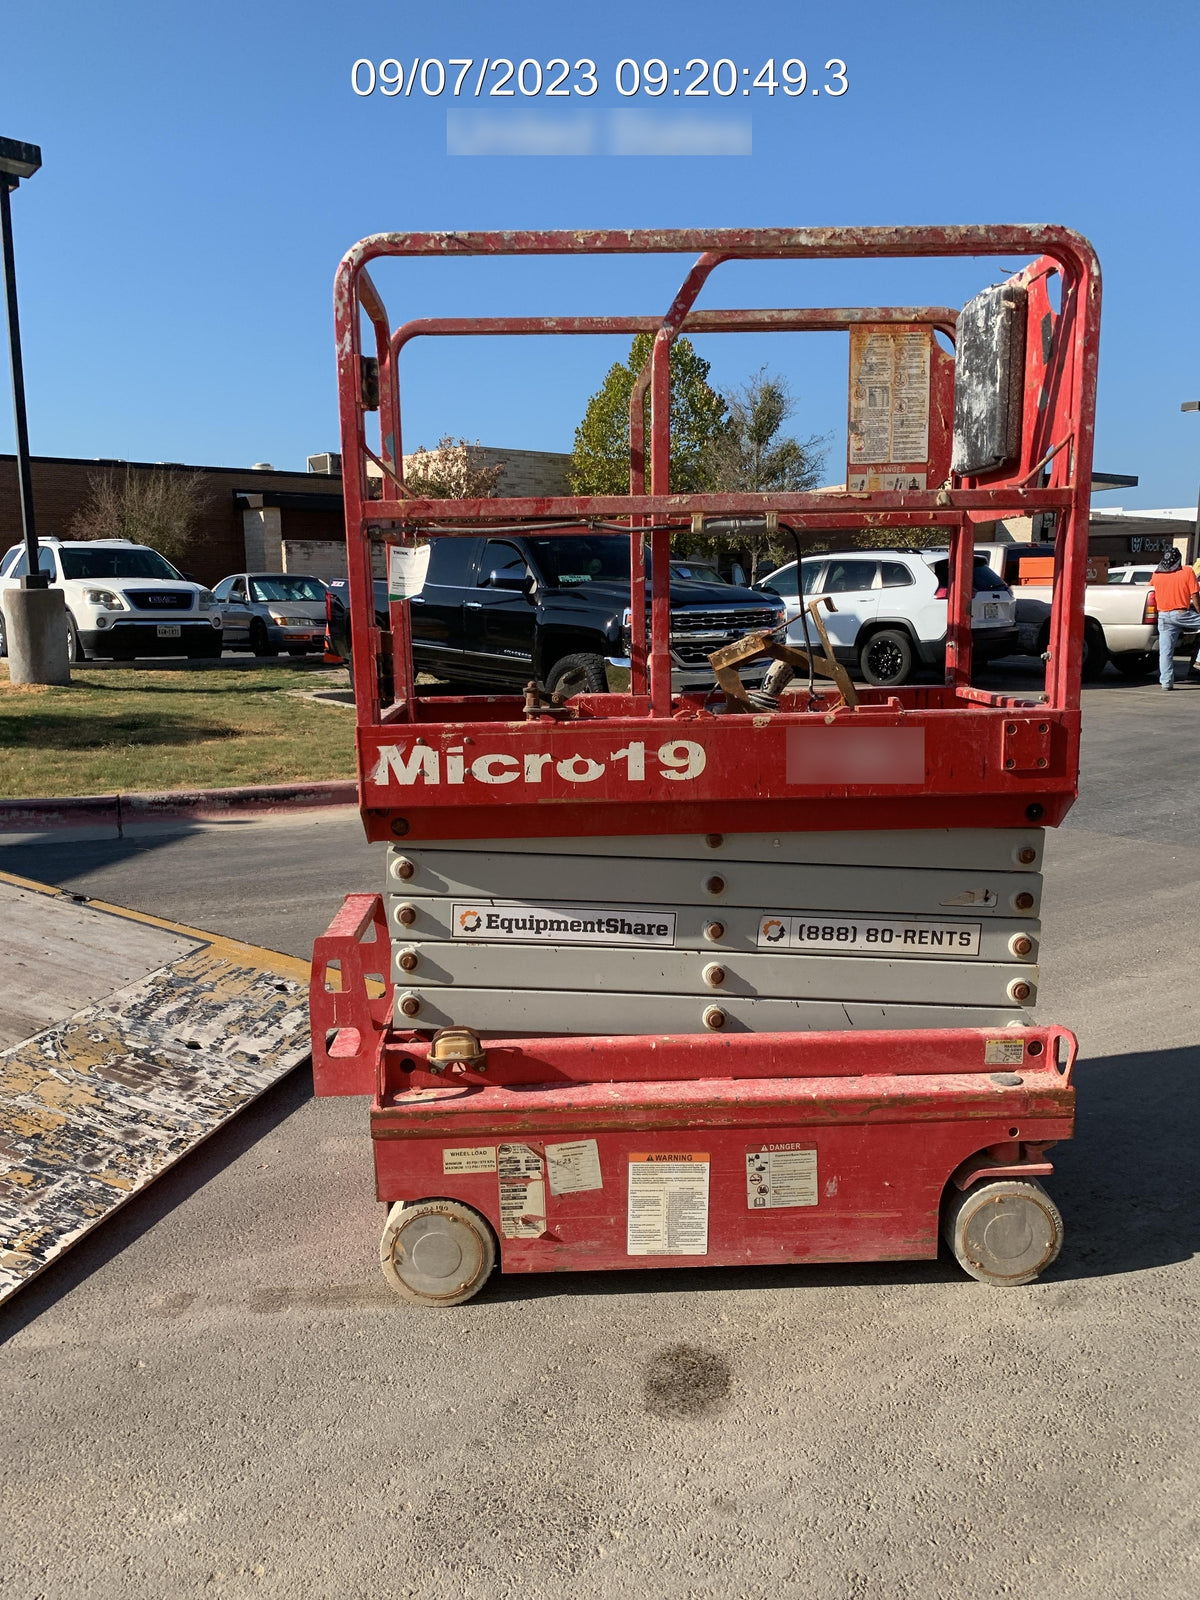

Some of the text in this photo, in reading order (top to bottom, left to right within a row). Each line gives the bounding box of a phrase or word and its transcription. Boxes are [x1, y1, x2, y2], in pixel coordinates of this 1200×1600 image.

[485, 913, 669, 937] EquipmentShare
[798, 923, 972, 947] (888) 80-RENTS
[769, 1143, 801, 1151] DANGER
